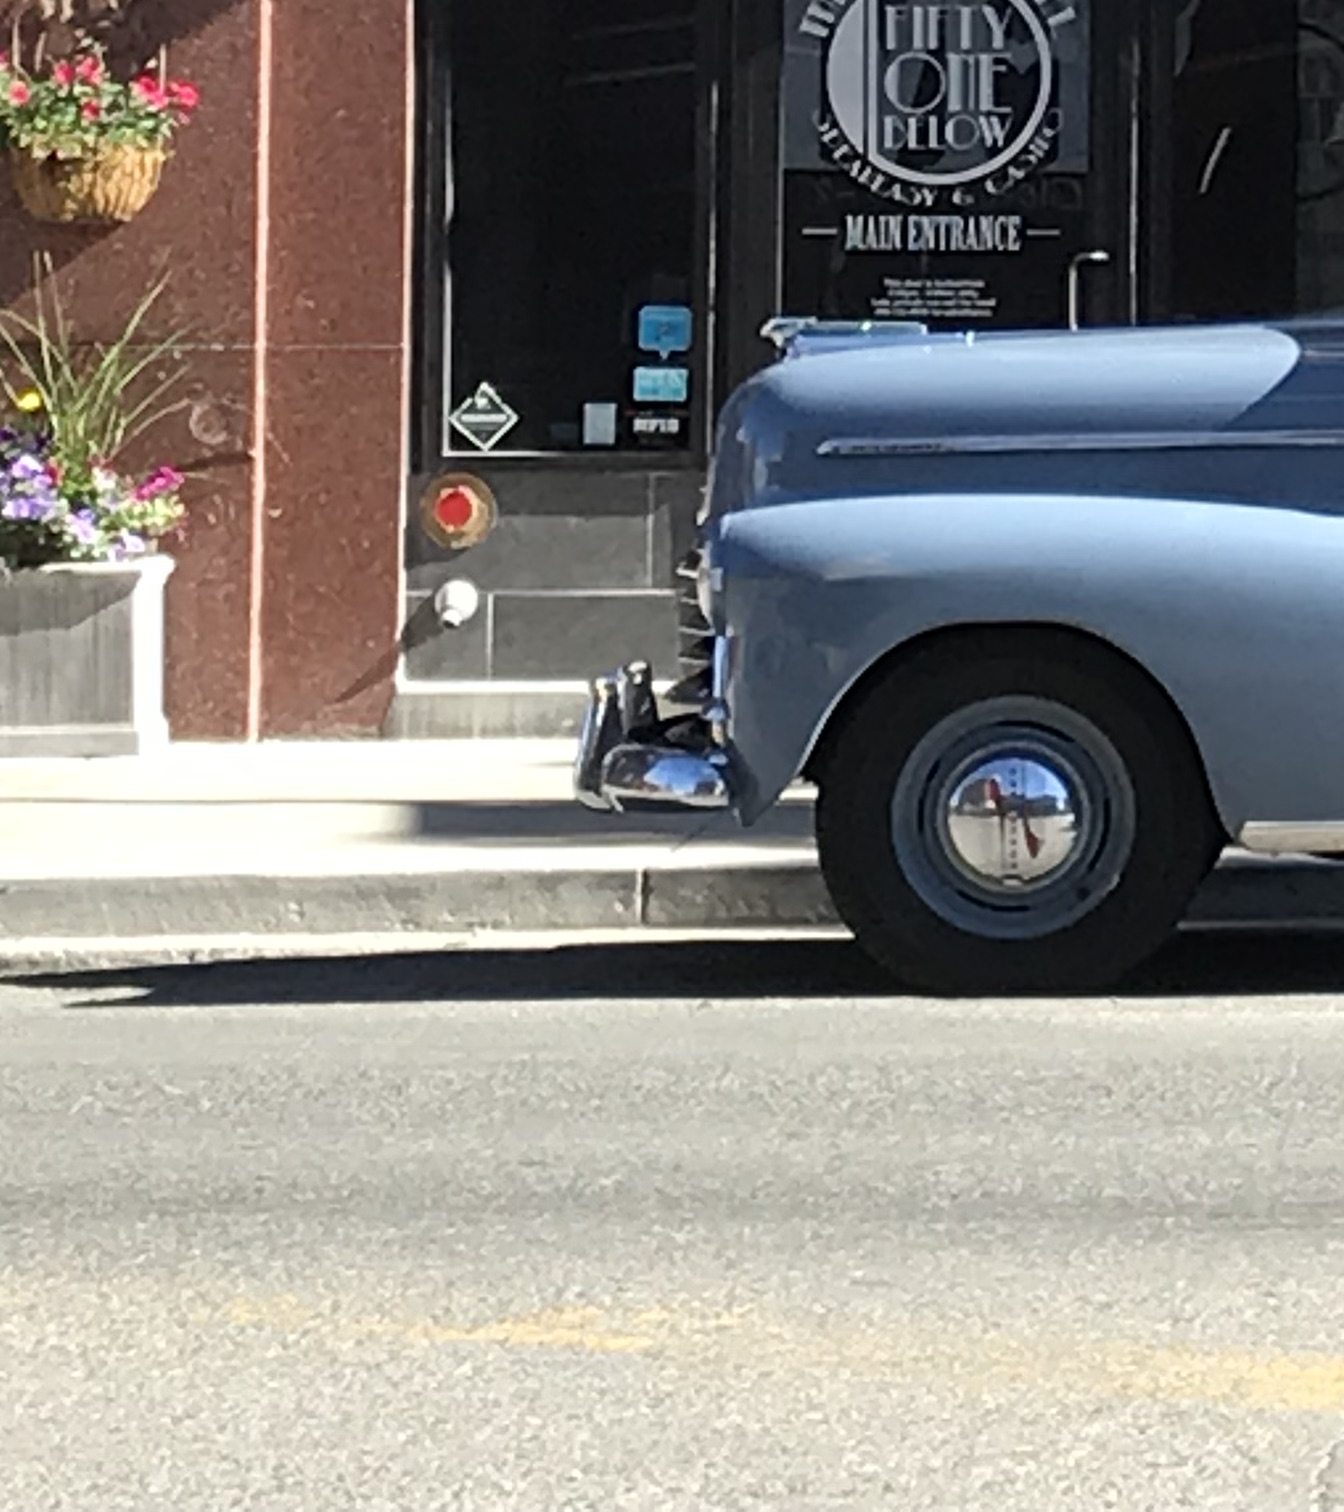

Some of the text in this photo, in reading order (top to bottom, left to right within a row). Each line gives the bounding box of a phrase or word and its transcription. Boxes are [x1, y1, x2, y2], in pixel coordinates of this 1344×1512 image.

[884, 5, 1012, 50] FIFTY
[884, 51, 1013, 115] ONE
[883, 115, 1013, 152] BELOW
[845, 214, 1021, 252] MAIN ENTRANCE
